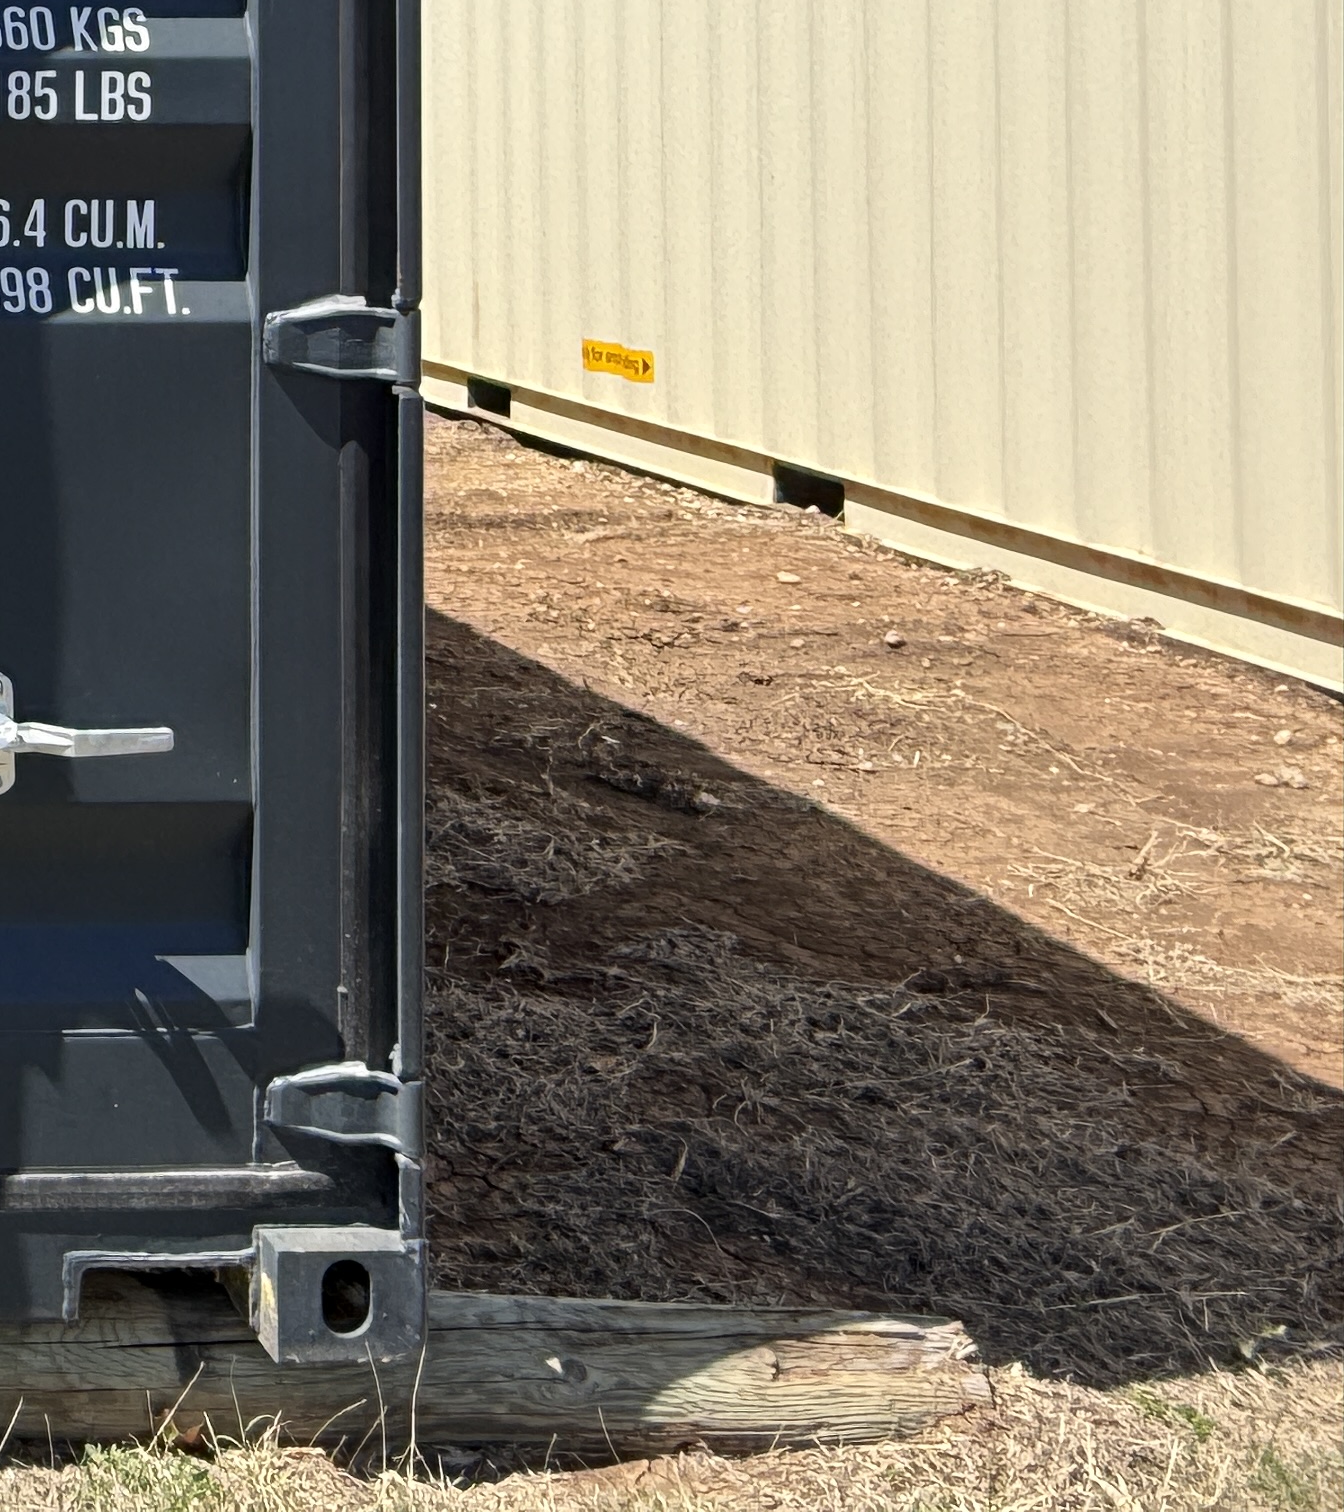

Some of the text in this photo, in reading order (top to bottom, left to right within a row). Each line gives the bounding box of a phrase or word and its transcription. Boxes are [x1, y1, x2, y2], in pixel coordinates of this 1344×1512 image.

[69, 6, 151, 52] KGS
[74, 70, 152, 122] LBS
[64, 199, 165, 249] CU.M.
[67, 267, 191, 316] CU.FT.
